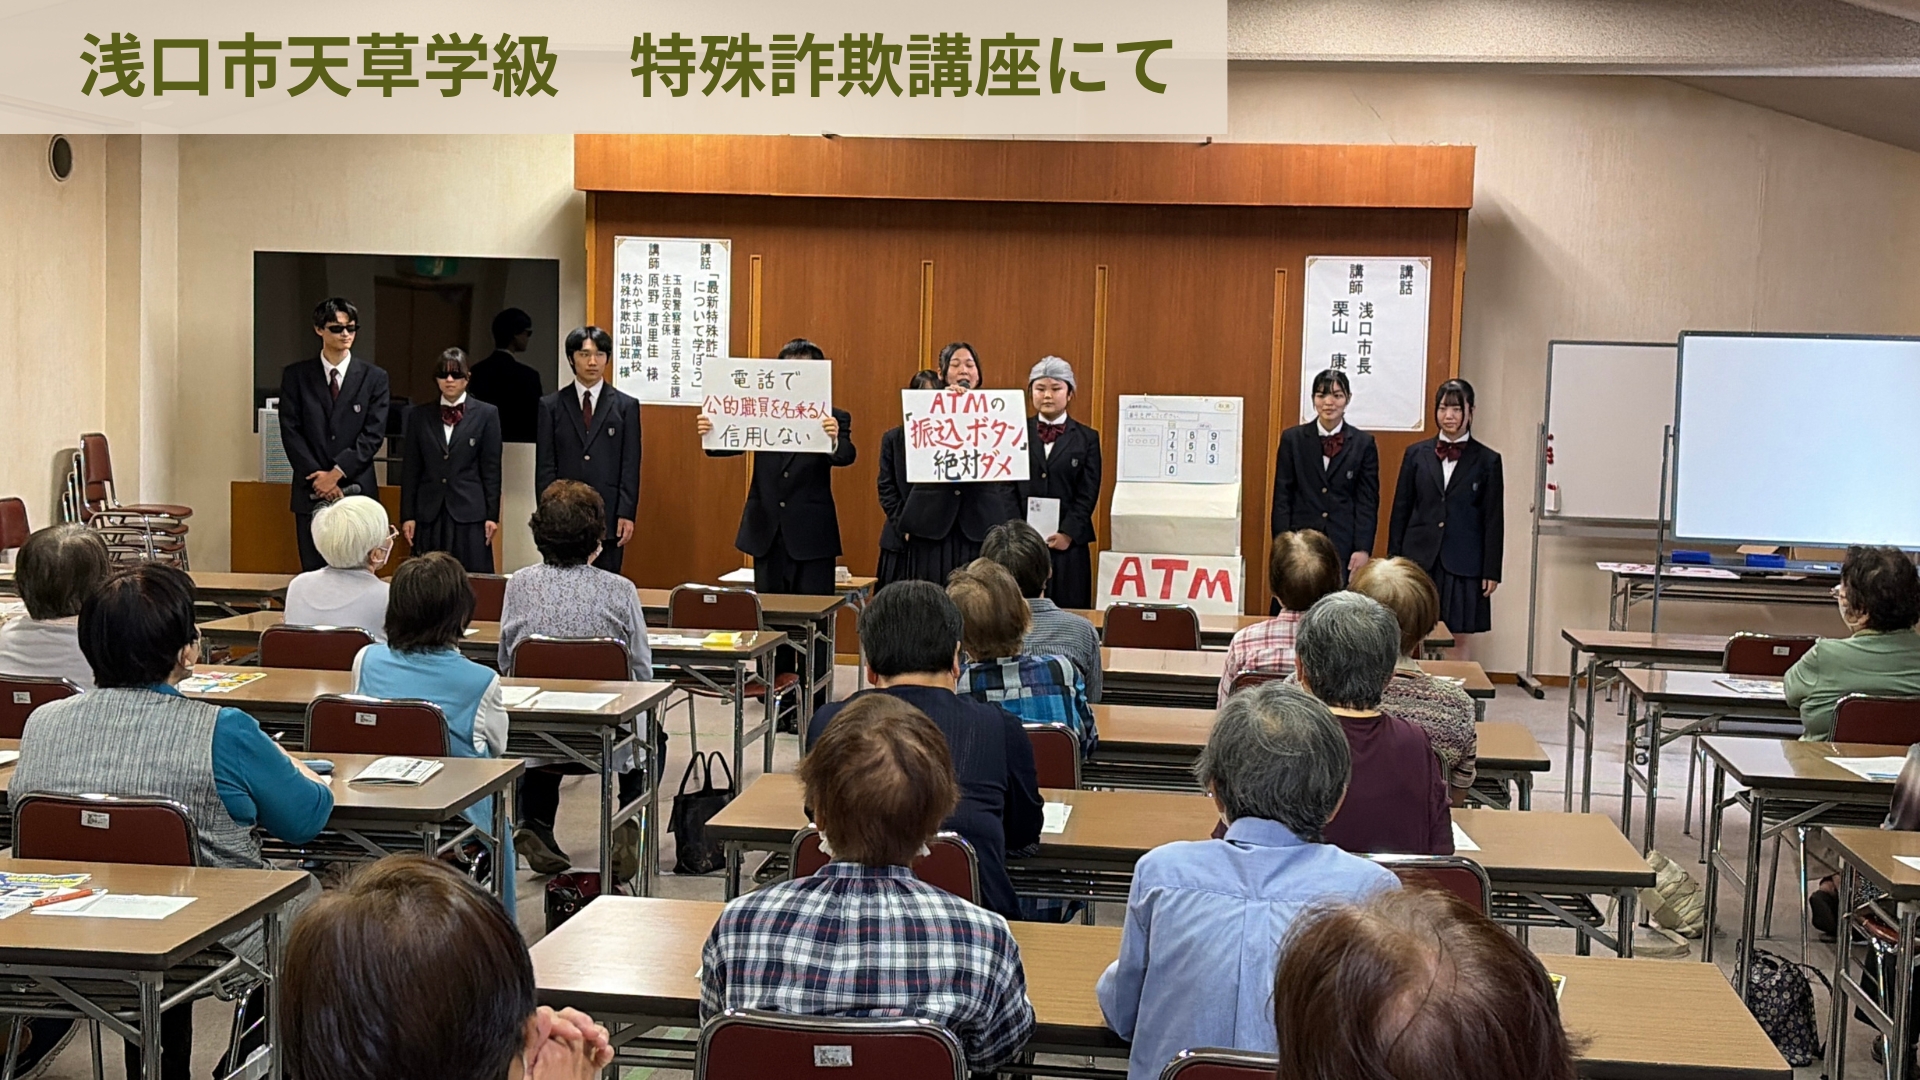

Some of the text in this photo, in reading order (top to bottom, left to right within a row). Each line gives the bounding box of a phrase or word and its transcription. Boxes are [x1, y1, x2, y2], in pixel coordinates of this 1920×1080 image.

[700, 243, 712, 270] 講話
[1349, 264, 1364, 295] 講師
[1399, 265, 1414, 295] 講話
[646, 243, 660, 382] 講師 原野 恵里佳 様
[662, 274, 672, 336] 生活安全係
[706, 273, 719, 359] 「最新特殊詐
[619, 273, 631, 378] 特殊詐欺防止班 様
[631, 273, 643, 373] おかやま山陽高校
[671, 274, 682, 398] 玉島警察署生活安全課
[1330, 300, 1349, 374] 栗山 康
[1357, 301, 1374, 375] 浅口市長
[731, 369, 801, 391] 電話で
[703, 394, 829, 420] 公的職員を名乗る人
[930, 392, 1006, 414] ATMの
[719, 424, 810, 448] 信用しない
[1169, 442, 1217, 451] 4 5 6
[1170, 431, 1218, 441] 7 8 9
[933, 449, 1013, 481] 絶対ダメ
[1168, 465, 1175, 475] 0
[1169, 453, 1216, 464] 1 2 3
[1111, 557, 1233, 602] ATM
